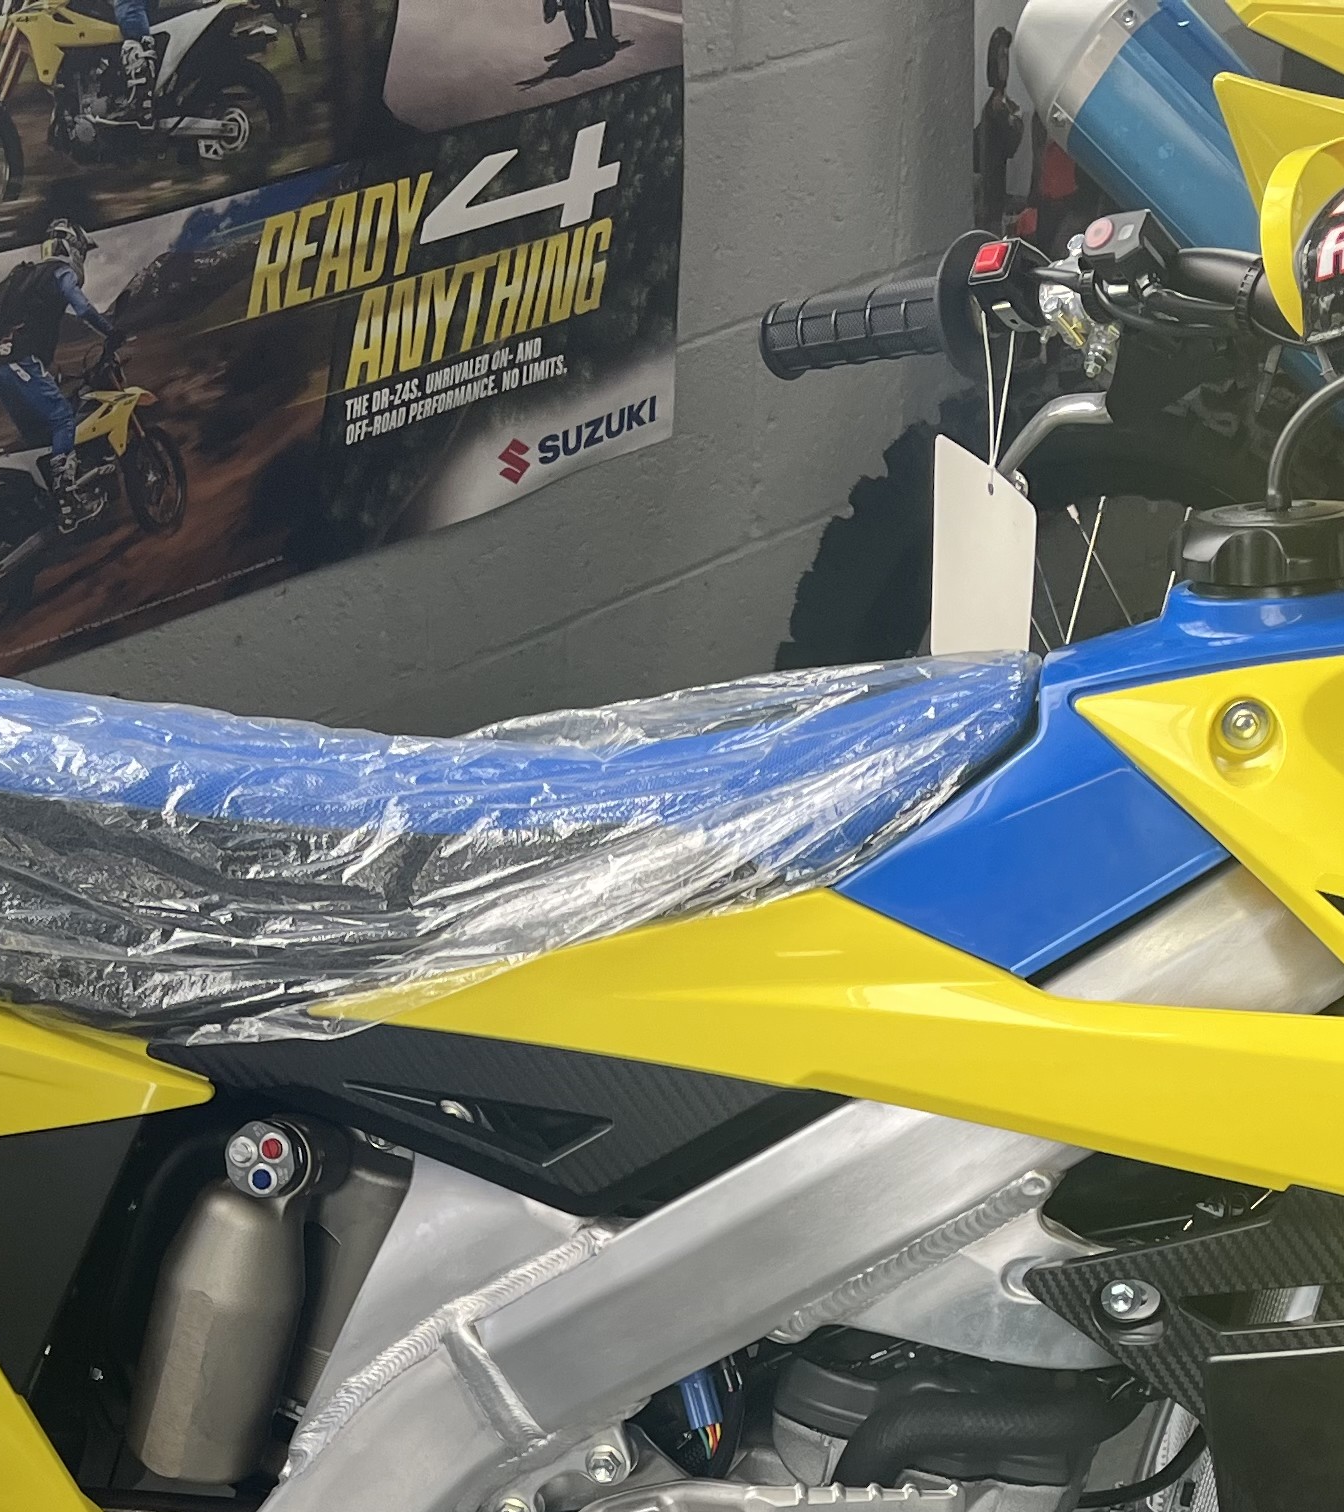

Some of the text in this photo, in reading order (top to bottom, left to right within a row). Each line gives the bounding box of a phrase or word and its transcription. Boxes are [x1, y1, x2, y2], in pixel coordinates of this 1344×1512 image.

[246, 121, 621, 319] READY 4
[345, 218, 613, 389] ANYTHING
[345, 337, 542, 421] THE DR-Z4S. UNRIVALED ON- AND
[345, 354, 568, 446] OFF-ROAD PERFORMANCE. NO LIMITS.
[537, 396, 657, 465] SUZUKI
